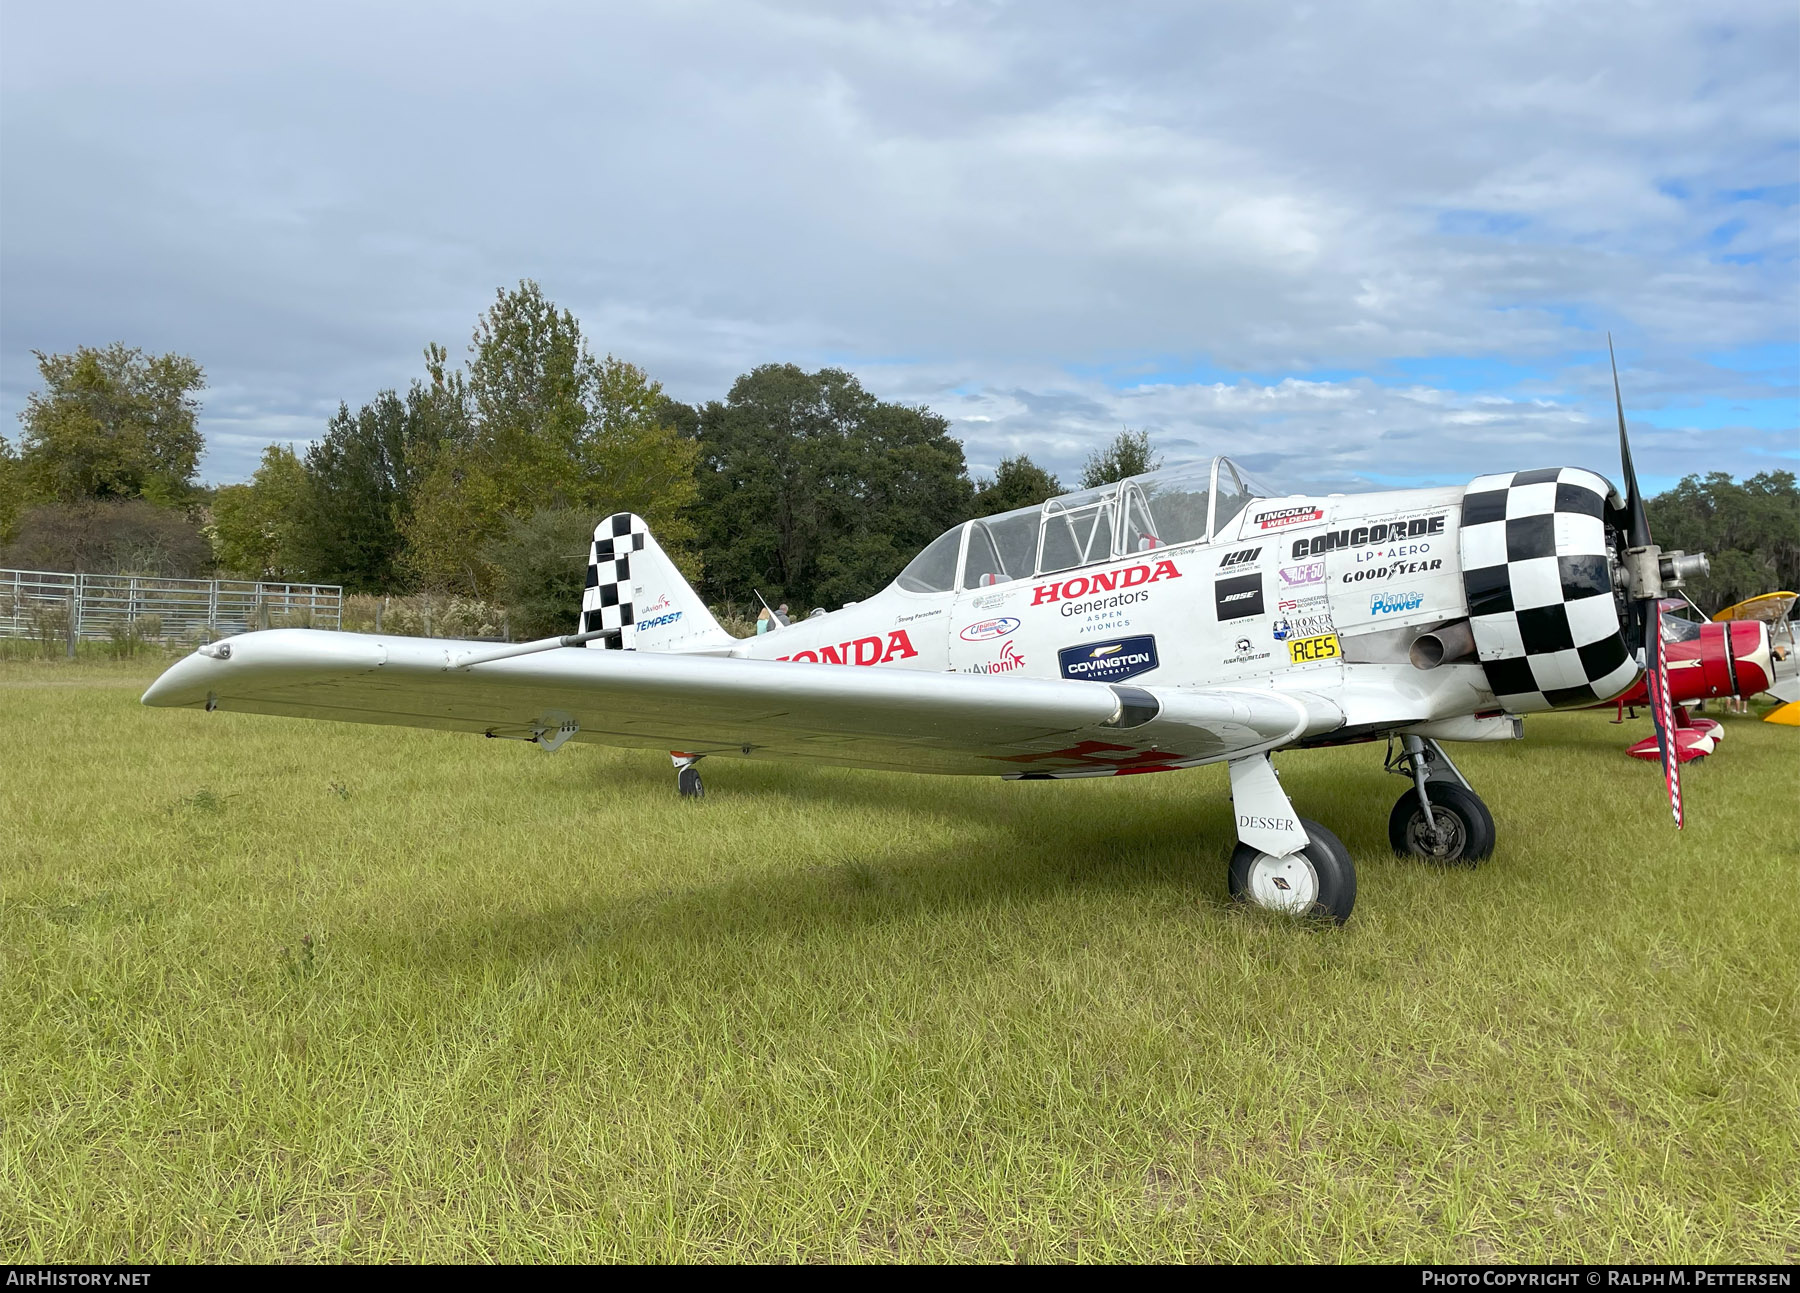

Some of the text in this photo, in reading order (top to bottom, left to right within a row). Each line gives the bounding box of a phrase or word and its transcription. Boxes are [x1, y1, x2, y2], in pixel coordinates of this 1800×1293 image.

[1256, 506, 1313, 523] LINCOLN
[1267, 513, 1316, 528] WELDERS
[1291, 515, 1445, 560] CONCORDE
[1356, 543, 1430, 563] LP AERO
[1289, 562, 1324, 582] ACF-50
[1030, 559, 1183, 606] HONDA
[1060, 590, 1149, 617] Generators
[1219, 590, 1259, 603] BOSE
[1371, 598, 1424, 615] Power
[636, 611, 683, 632] TEMPEST
[1087, 610, 1122, 622] ASPEN
[1229, 618, 1255, 626] AVIATION
[1290, 613, 1333, 629] HOOKER
[1080, 619, 1131, 633] AVIONICS
[1291, 624, 1336, 638] HARNESS
[776, 629, 918, 666] NDA
[1293, 637, 1335, 661] ACES
[1067, 652, 1150, 674] COVINGTON
[1087, 667, 1131, 678] AIRCRAFT
[1239, 815, 1294, 831] DESSER
